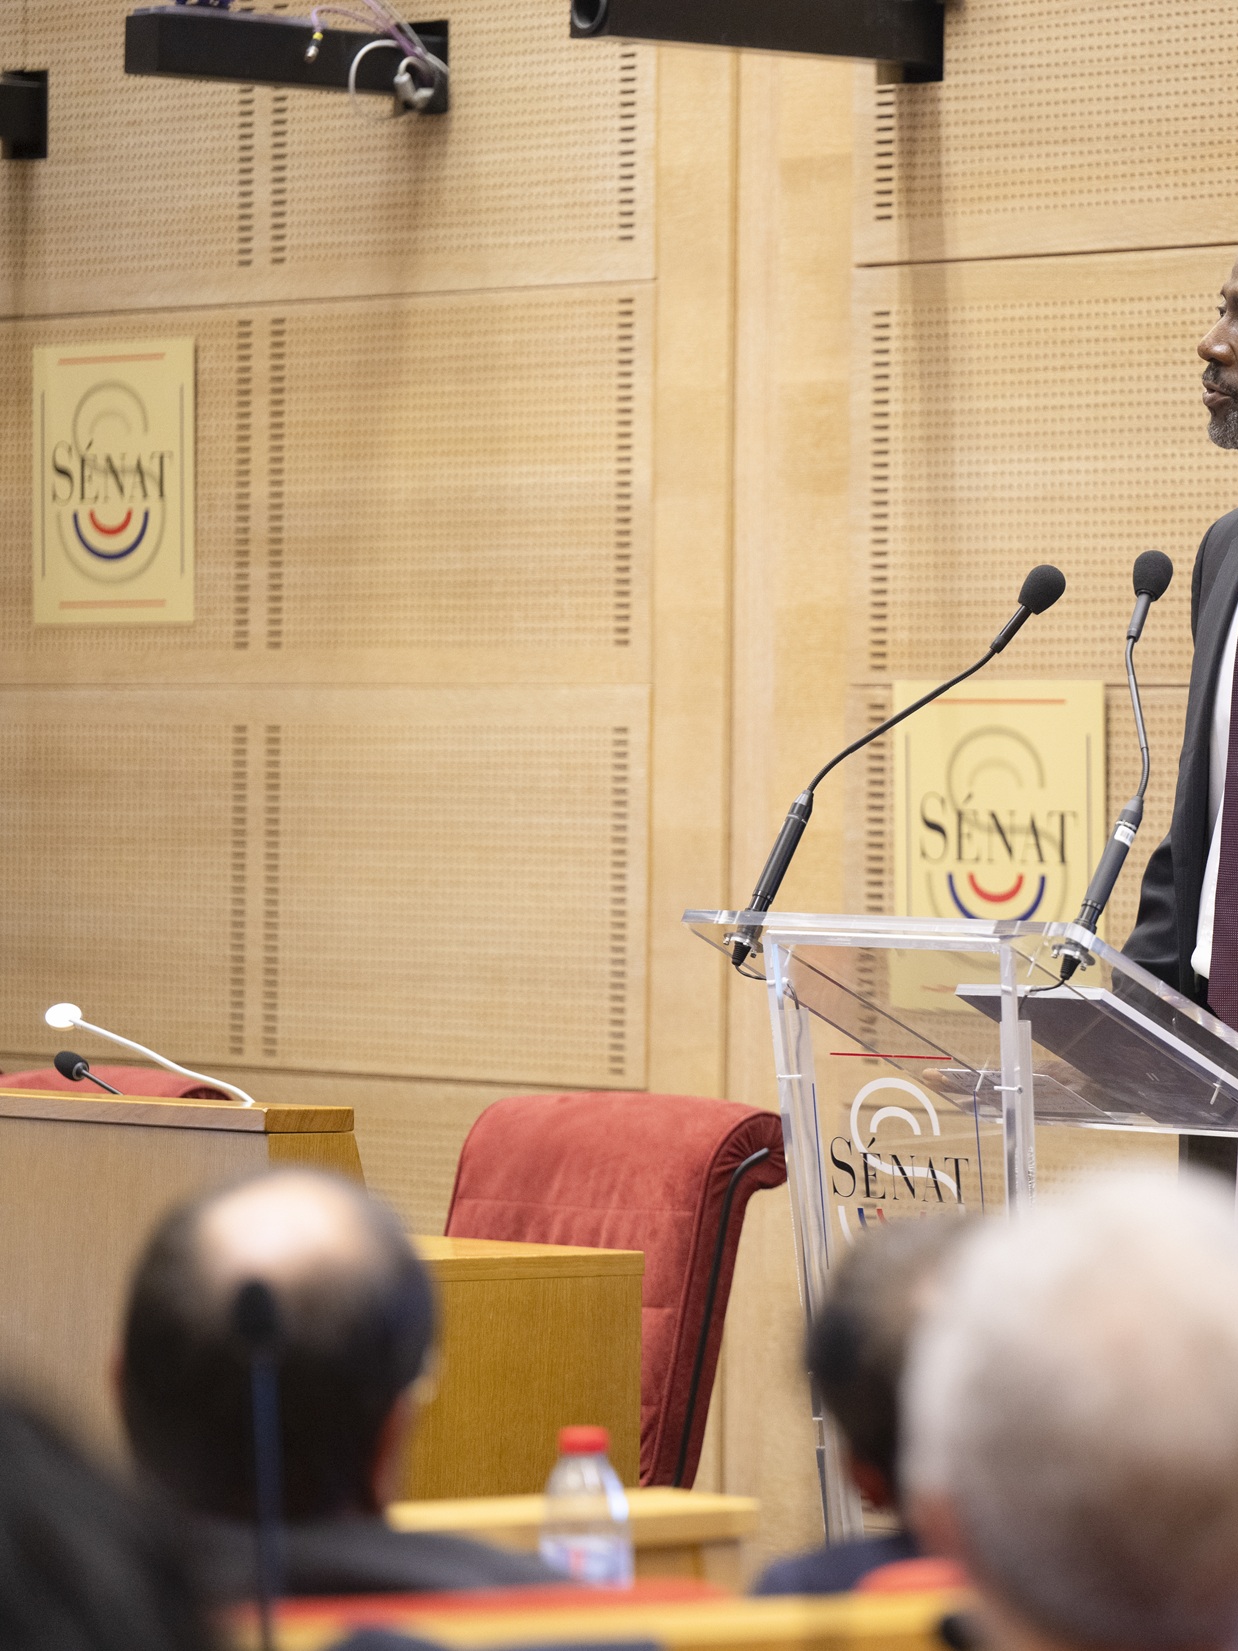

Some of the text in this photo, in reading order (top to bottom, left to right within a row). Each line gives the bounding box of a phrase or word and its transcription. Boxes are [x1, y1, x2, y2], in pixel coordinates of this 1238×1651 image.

[51, 438, 174, 505] SÉNAT
[919, 791, 1078, 865] SÉNAT
[830, 1135, 969, 1204] SÉNAT
